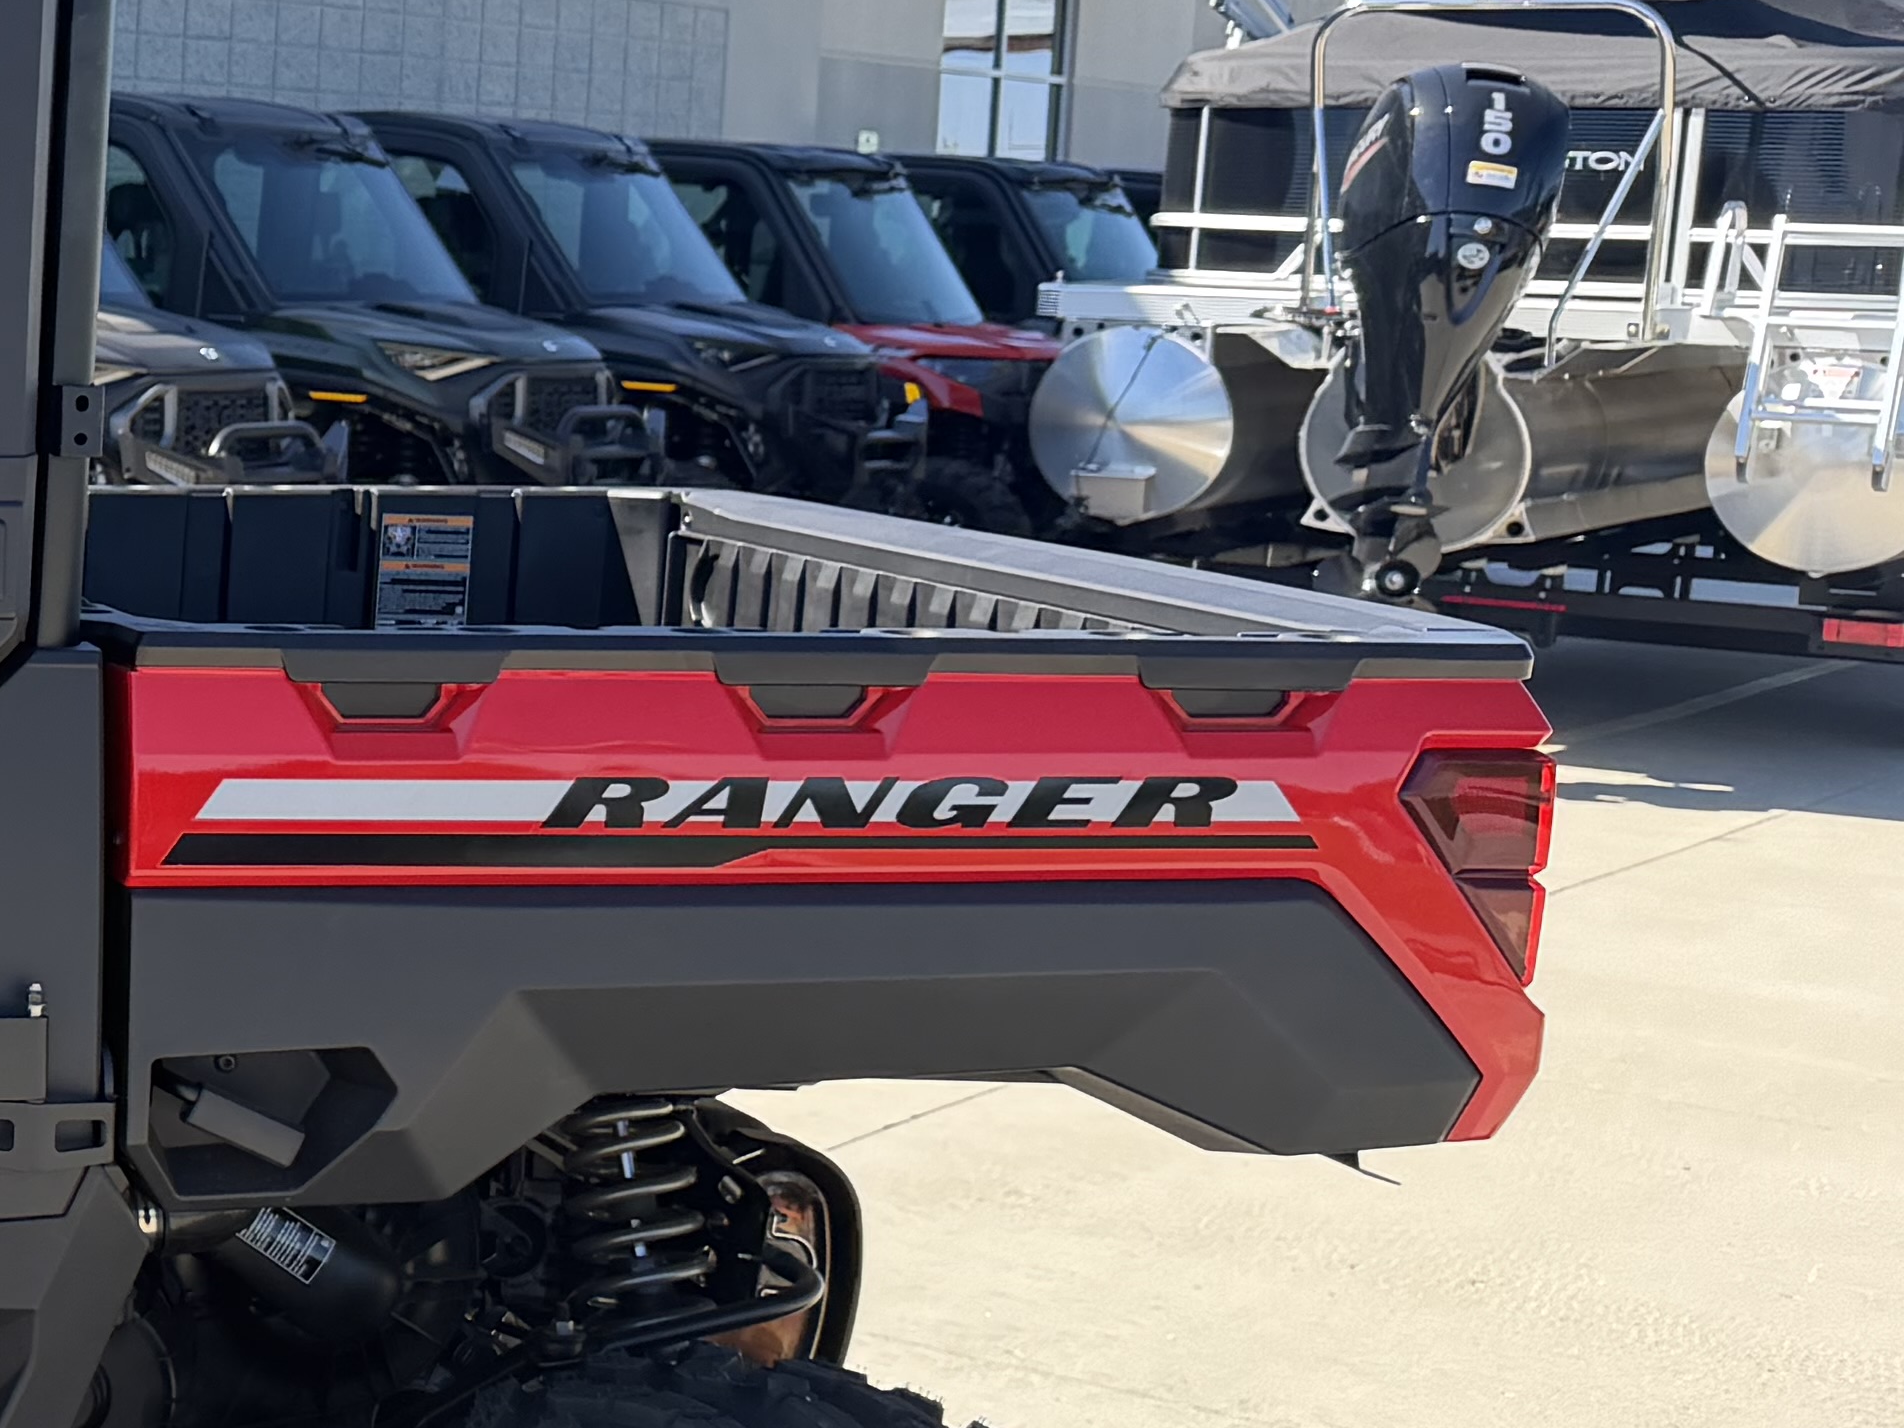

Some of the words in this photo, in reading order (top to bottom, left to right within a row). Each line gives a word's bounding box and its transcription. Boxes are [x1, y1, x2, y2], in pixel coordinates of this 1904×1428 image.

[1479, 91, 1514, 156] 150
[1565, 150, 1645, 171] TON
[536, 775, 1242, 831] RANGER
